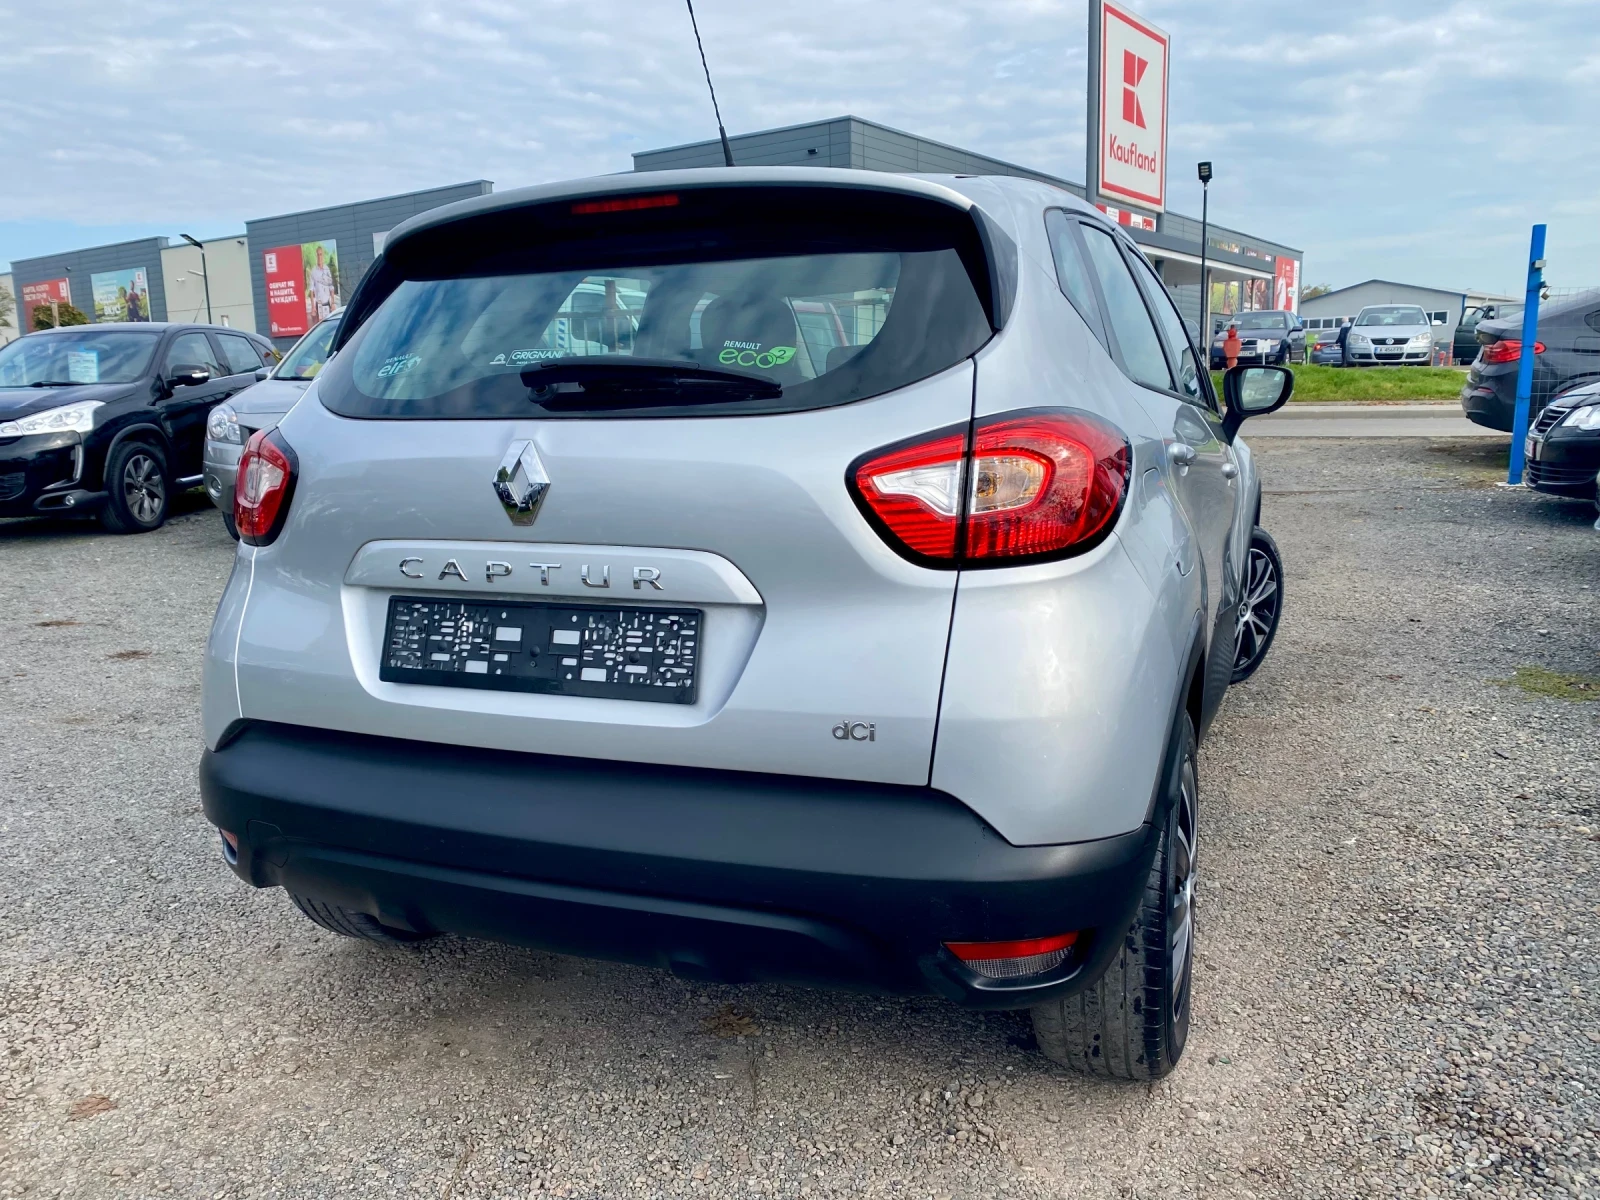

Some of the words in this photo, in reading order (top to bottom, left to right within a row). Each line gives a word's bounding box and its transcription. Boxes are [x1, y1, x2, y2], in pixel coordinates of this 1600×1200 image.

[1109, 133, 1157, 175] Kaufland
[723, 340, 762, 350] RENAULT
[377, 360, 408, 377] elf
[398, 556, 665, 591] CAPTUR
[831, 720, 876, 742] dCi
